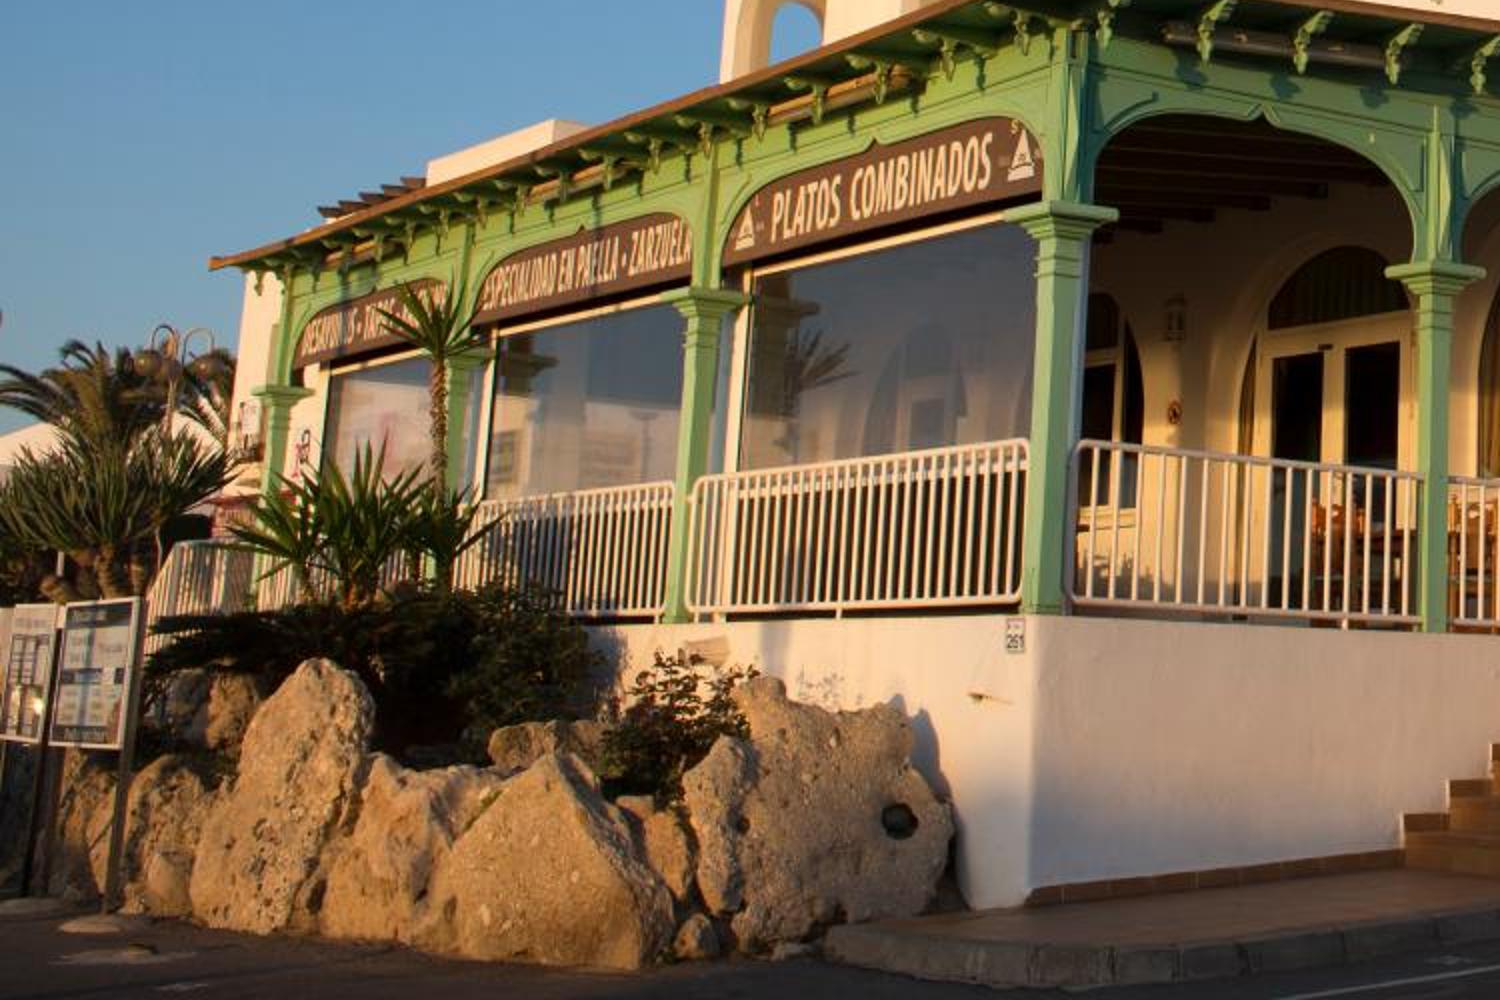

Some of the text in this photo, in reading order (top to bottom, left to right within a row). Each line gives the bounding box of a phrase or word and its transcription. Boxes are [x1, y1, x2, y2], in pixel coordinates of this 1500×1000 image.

[770, 132, 993, 244] PLATOS COMBINADOS
[557, 247, 576, 293] EN
[575, 235, 620, 288] PAELLA
[628, 218, 692, 277] ZARZUELA
